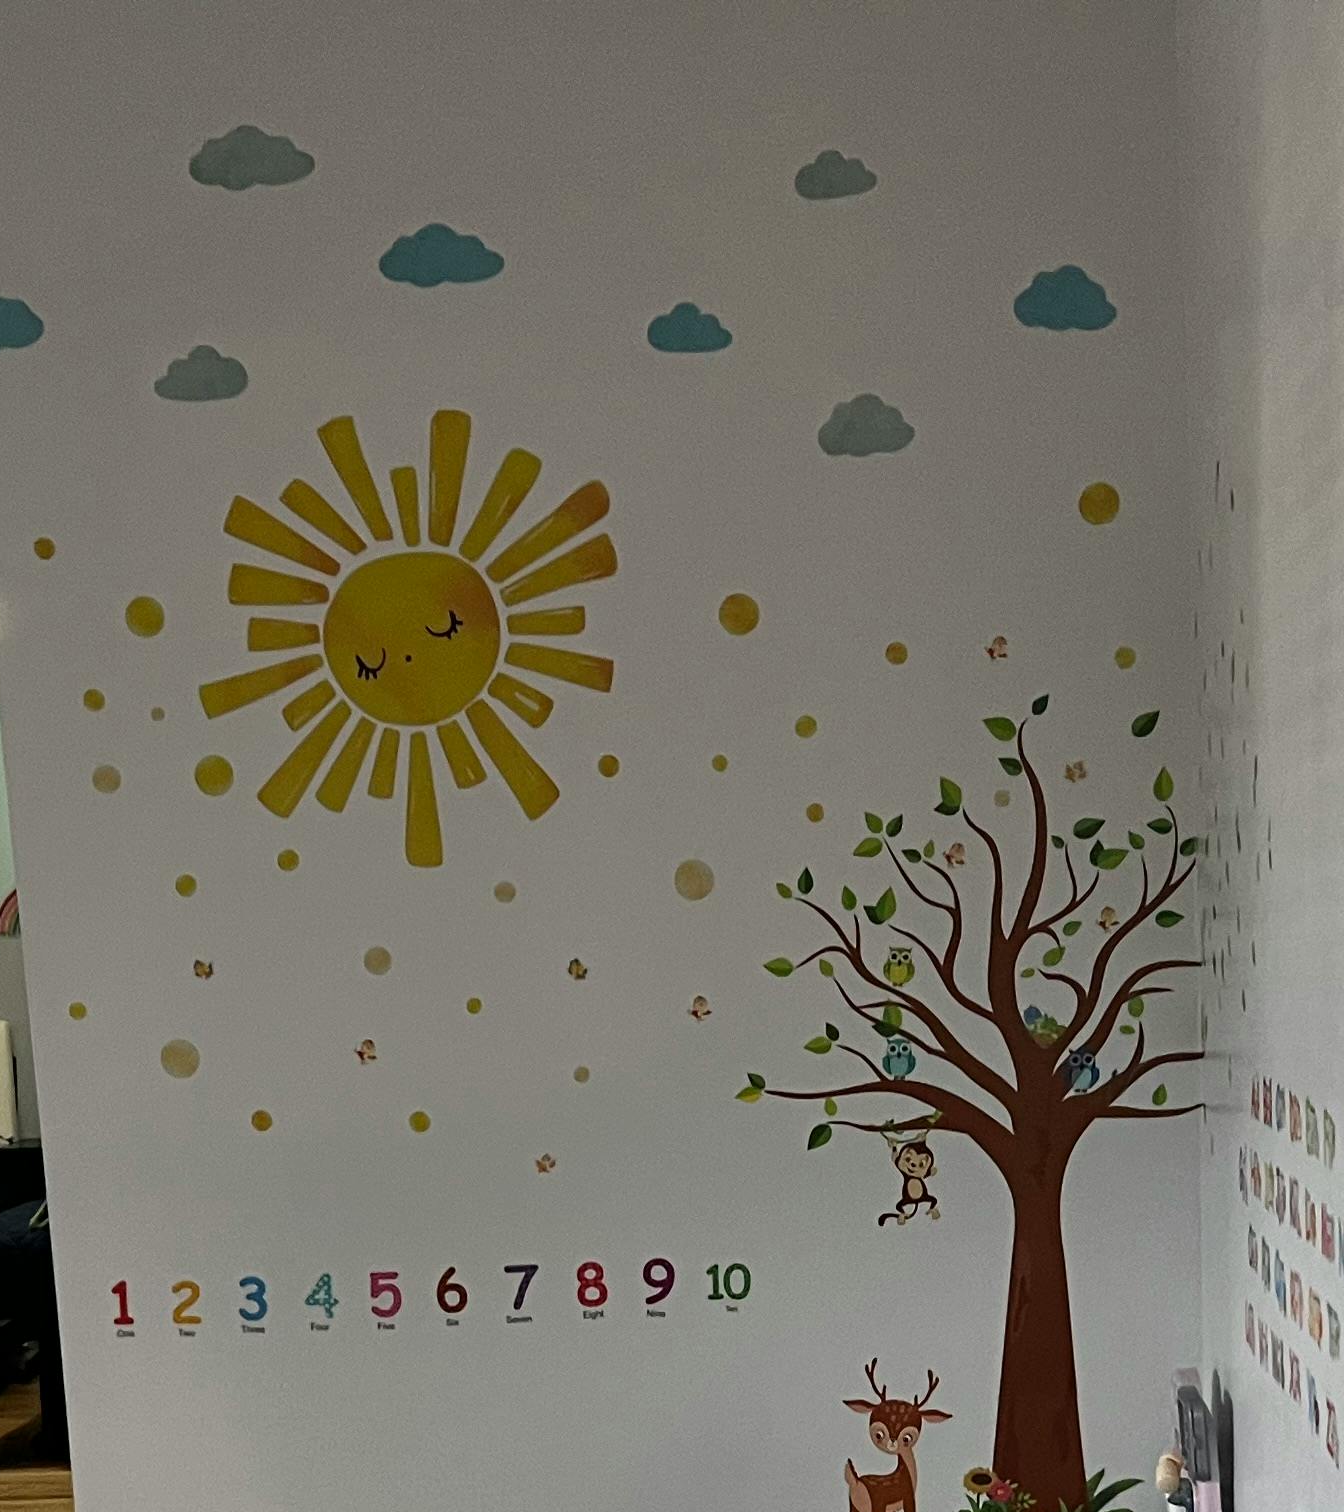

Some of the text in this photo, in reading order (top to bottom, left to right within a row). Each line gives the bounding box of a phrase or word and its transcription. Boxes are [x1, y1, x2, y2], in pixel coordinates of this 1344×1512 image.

[111, 1257, 752, 1327] 1 2 3 4 5 6 7 8 9 10
